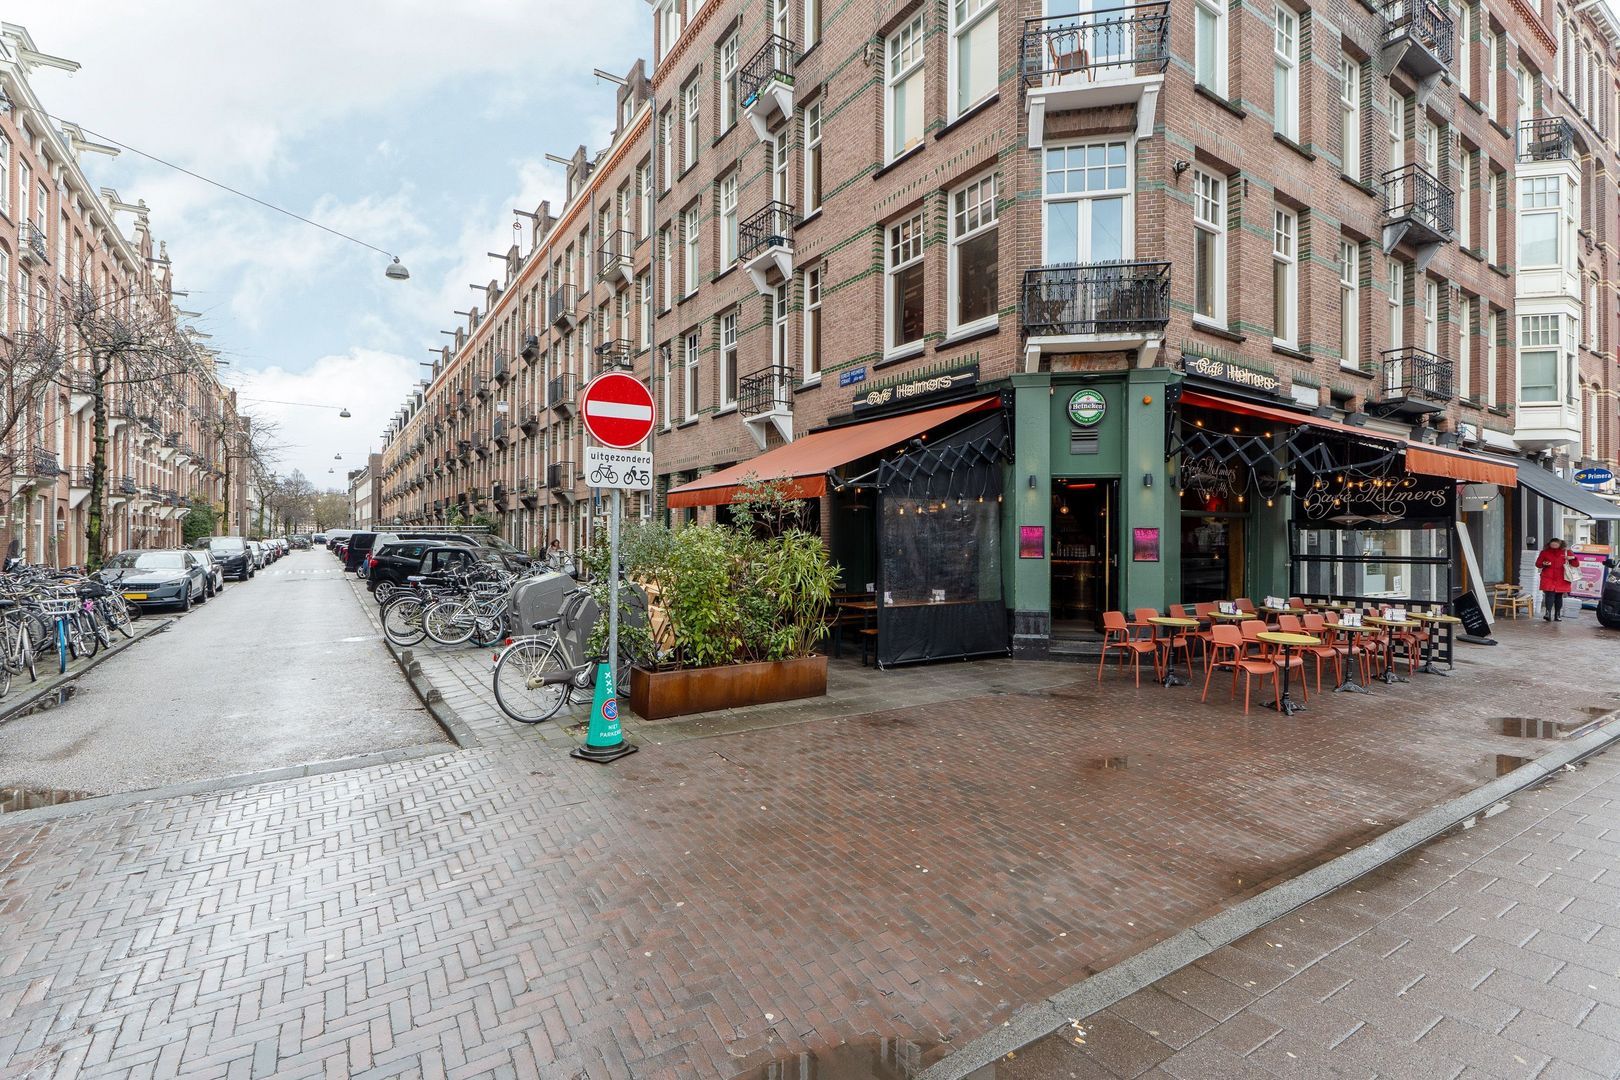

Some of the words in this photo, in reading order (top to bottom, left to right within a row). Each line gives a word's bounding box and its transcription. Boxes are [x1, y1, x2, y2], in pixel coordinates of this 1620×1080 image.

[1196, 357, 1224, 377] Café
[1226, 364, 1275, 390] Helmers
[866, 388, 893, 405] Café
[896, 375, 952, 399] Helmers
[591, 452, 651, 464] uitgezonderd
